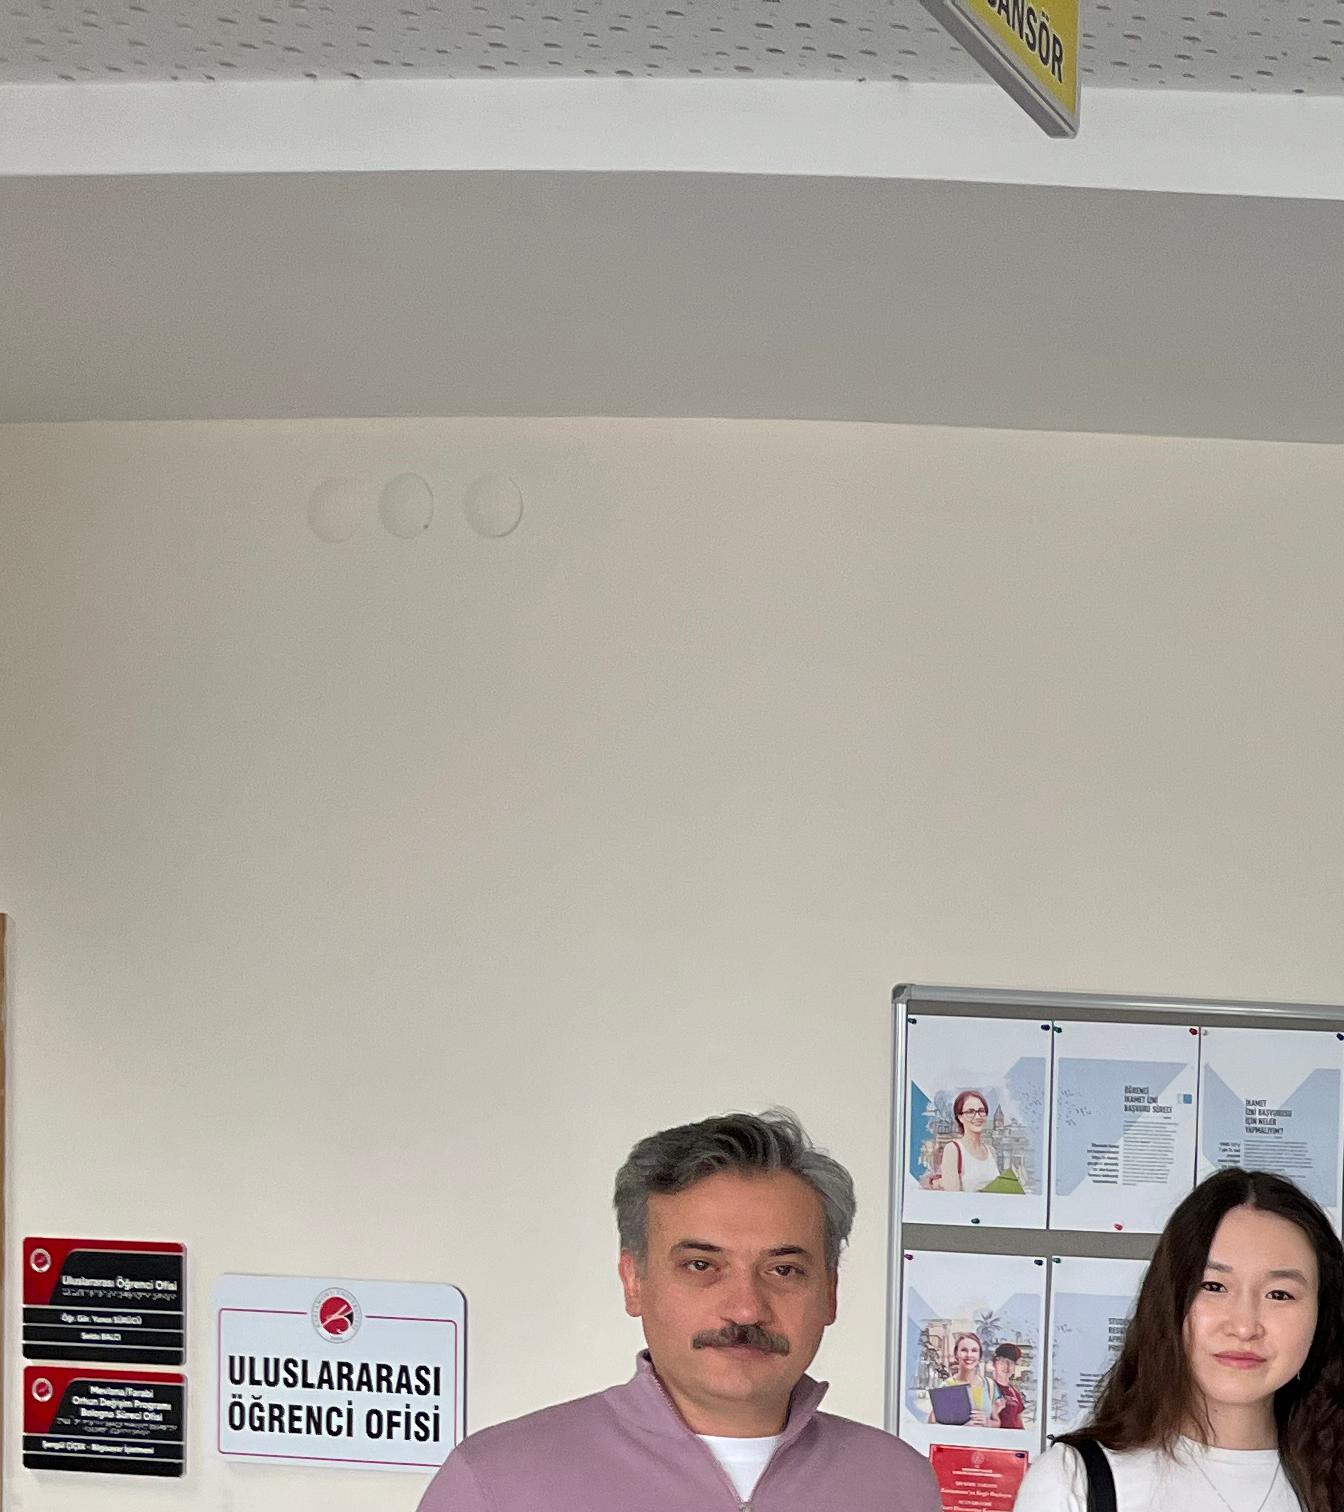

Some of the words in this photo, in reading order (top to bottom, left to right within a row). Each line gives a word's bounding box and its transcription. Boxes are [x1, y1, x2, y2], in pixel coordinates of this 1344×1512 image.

[228, 1355, 441, 1396] ULUSLARARASI
[228, 1393, 354, 1438] ÖĞRENCİ
[365, 1403, 440, 1442] OFİSİ
